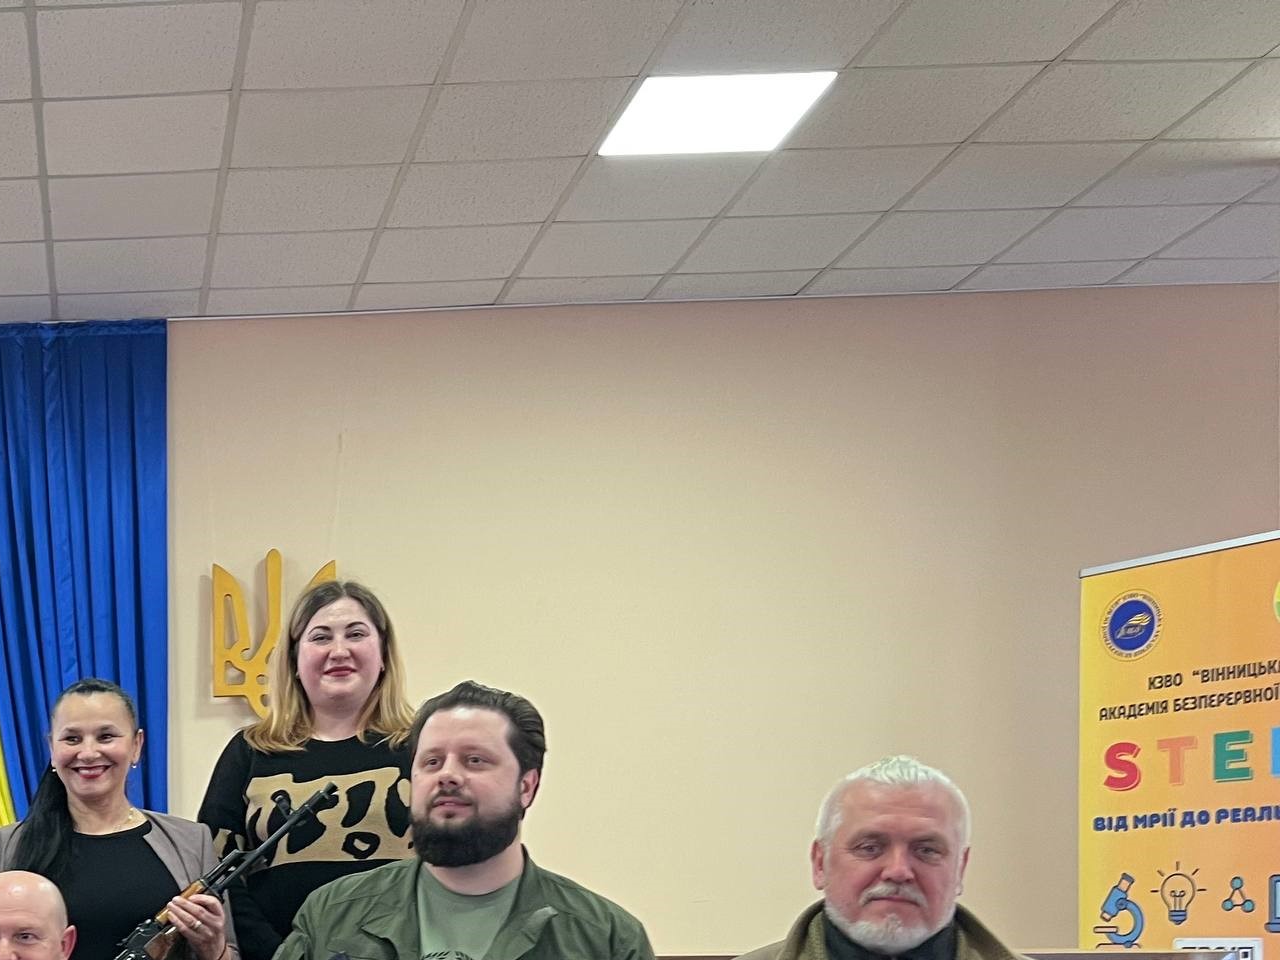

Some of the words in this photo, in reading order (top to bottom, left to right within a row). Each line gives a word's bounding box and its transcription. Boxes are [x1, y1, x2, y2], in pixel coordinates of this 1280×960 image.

[1147, 673, 1183, 690] КЗВО
[1099, 699, 1169, 721] АКАДЕМІЯ
[1173, 682, 1280, 712] БЕЗПЕРЕРВНОЇ
[1093, 815, 1128, 832] ВІД
[1132, 807, 1177, 829] МРІЇ
[1180, 809, 1210, 828] ДО
